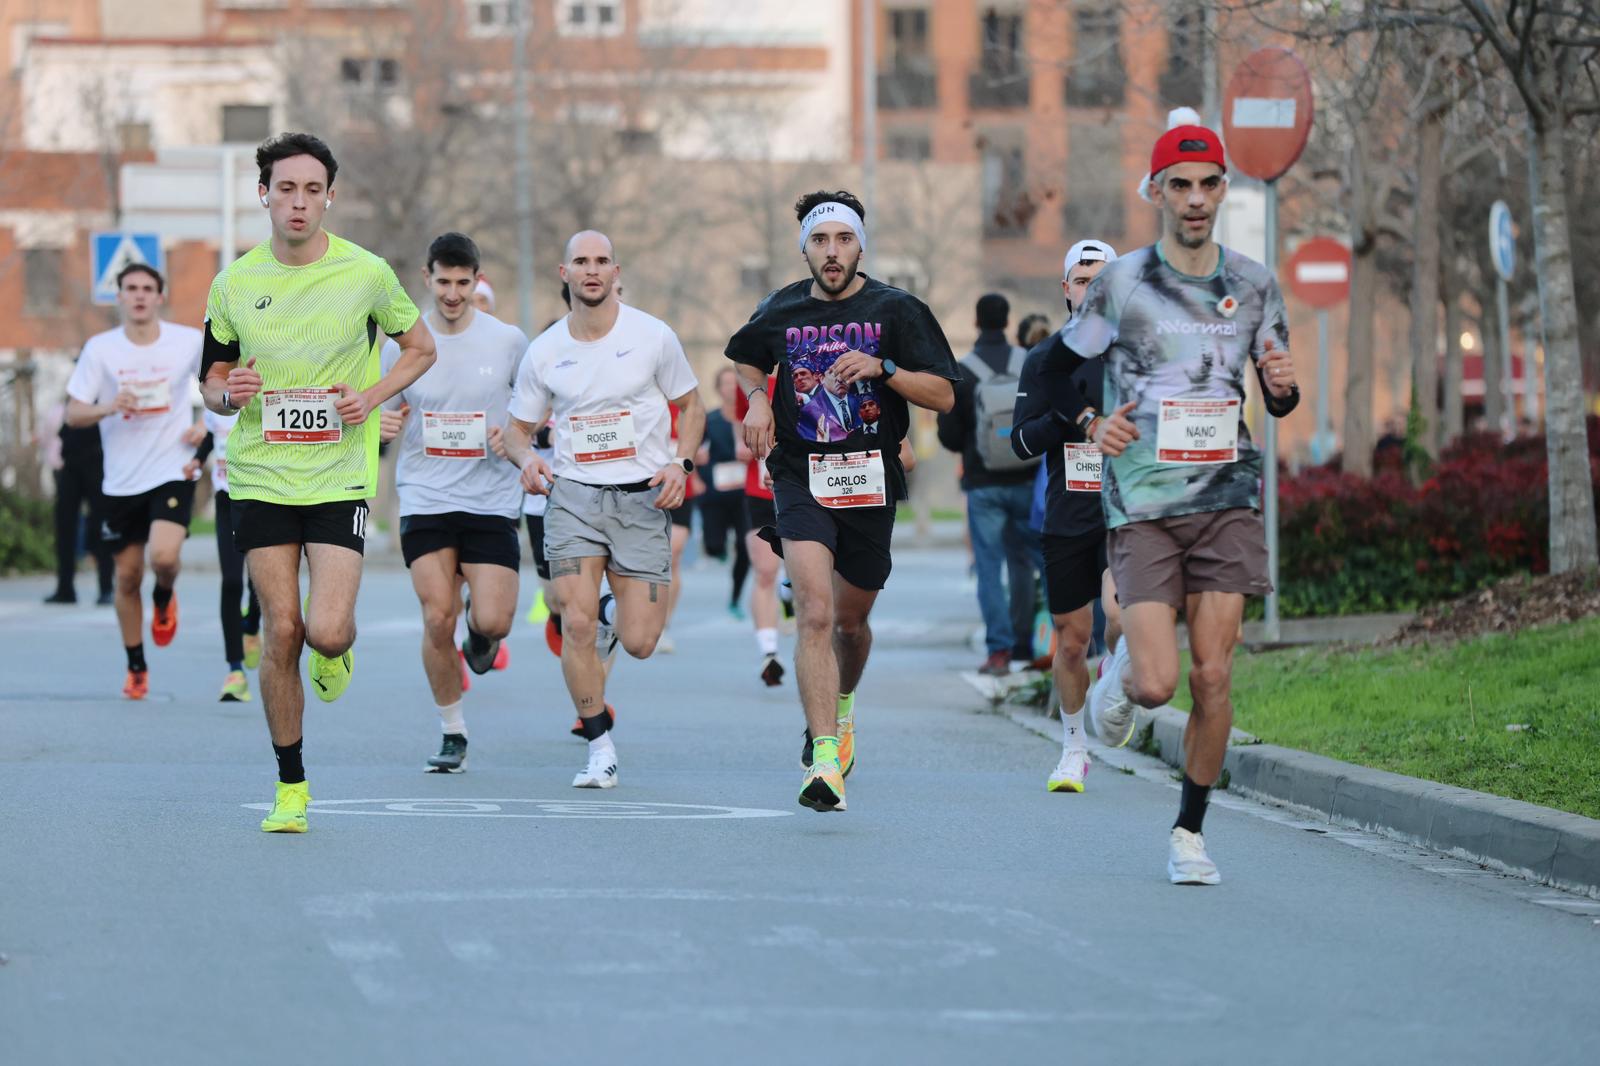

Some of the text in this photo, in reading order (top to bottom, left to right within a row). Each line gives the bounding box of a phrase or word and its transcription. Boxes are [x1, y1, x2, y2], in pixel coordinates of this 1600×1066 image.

[277, 408, 328, 430] 1205
[442, 431, 466, 440] DAVID
[587, 431, 617, 443] ROGER
[1186, 426, 1216, 437] NANO
[1076, 462, 1103, 471] CHRIS
[827, 474, 867, 487] CARLOS
